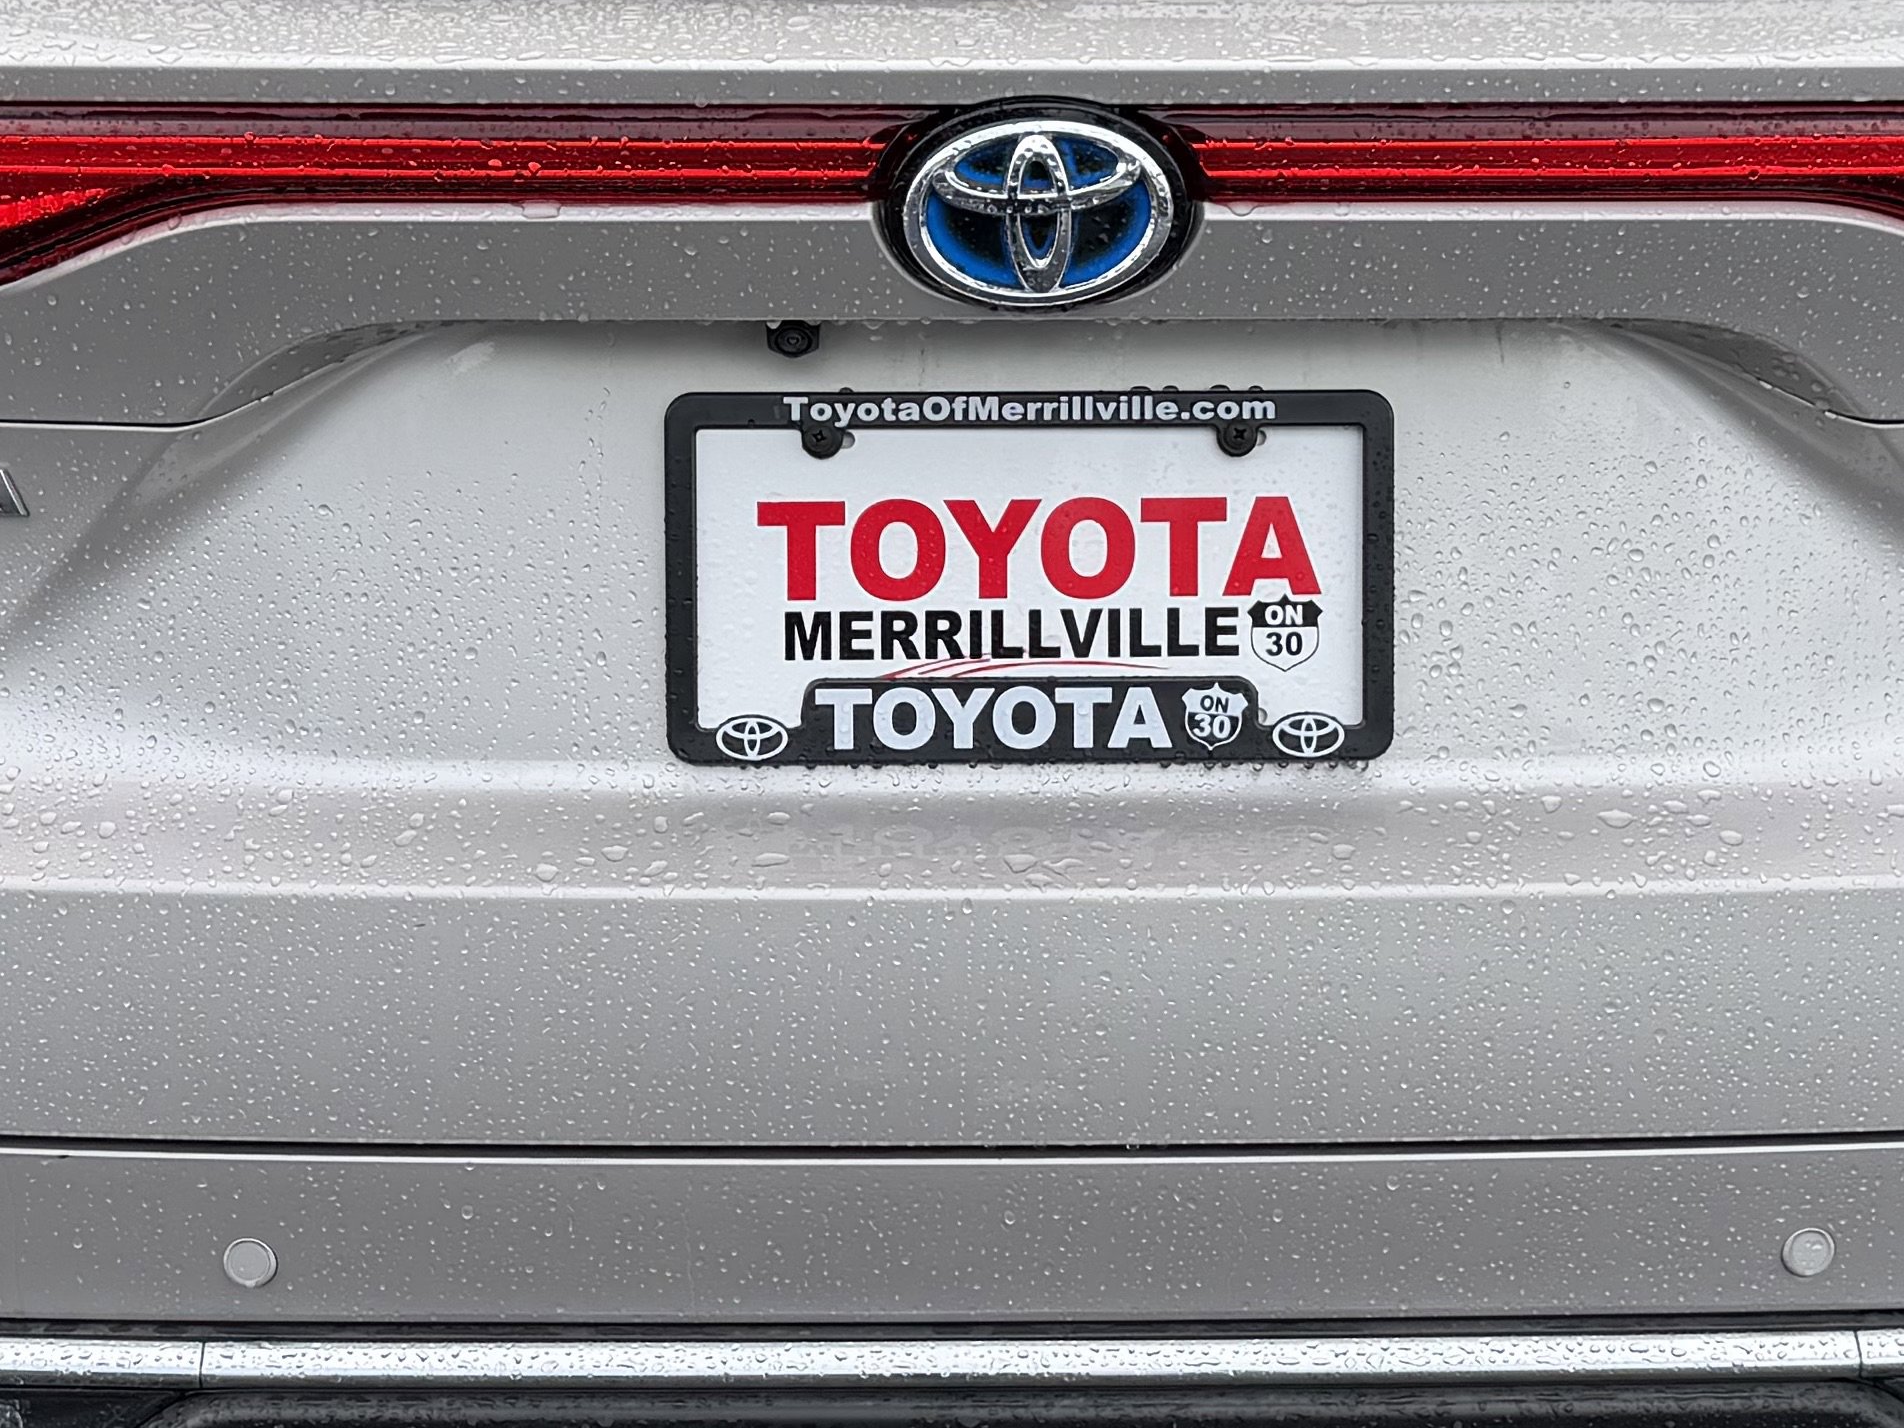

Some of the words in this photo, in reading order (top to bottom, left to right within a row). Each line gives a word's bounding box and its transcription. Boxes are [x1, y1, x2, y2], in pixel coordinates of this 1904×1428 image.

[783, 395, 1277, 424] ToyotaOfMerrillville.com
[757, 496, 1322, 601] TOYOTA
[1264, 604, 1304, 626] ON
[783, 606, 1240, 661] MERRILLVILLE
[1265, 631, 1303, 657] 30
[1199, 694, 1230, 714] ON
[815, 686, 1173, 751] TOYOTA
[1192, 713, 1232, 740] 30
